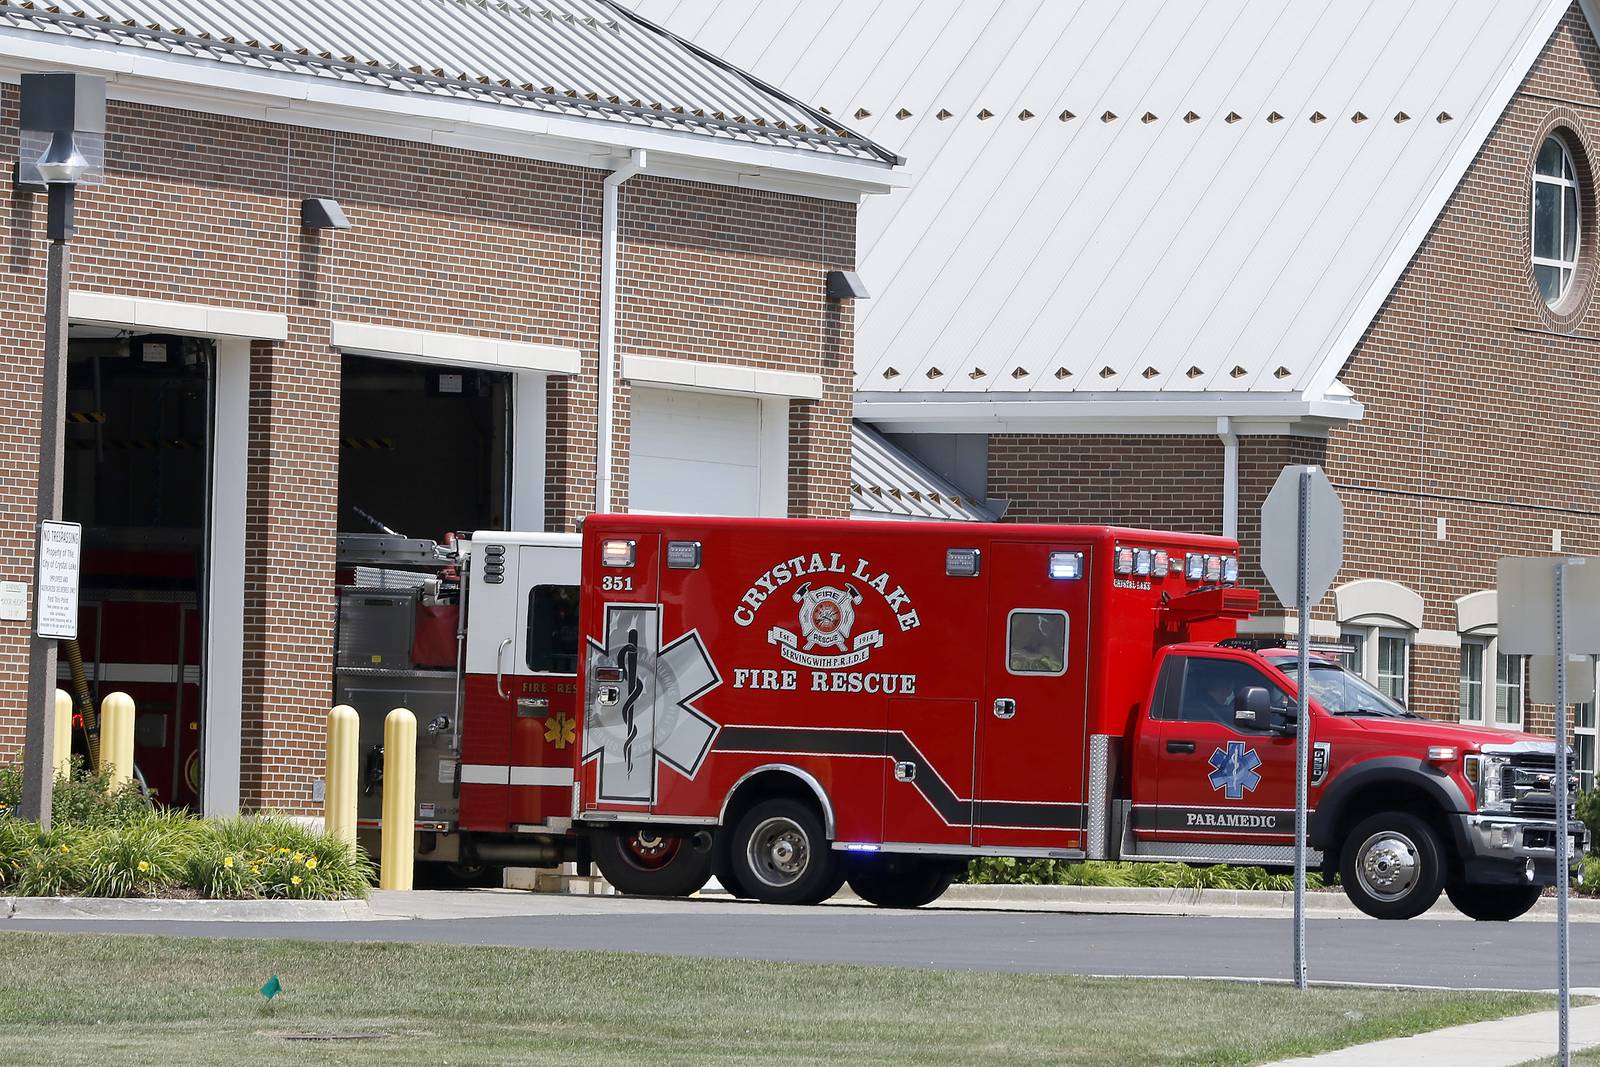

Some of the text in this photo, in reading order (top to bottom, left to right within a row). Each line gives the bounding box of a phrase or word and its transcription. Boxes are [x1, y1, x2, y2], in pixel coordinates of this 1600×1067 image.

[43, 530, 79, 544] NO TRESPASSING
[46, 547, 61, 559] Property
[42, 559, 50, 570] City
[55, 560, 67, 571] Crystal
[602, 575, 633, 591] 351
[733, 552, 921, 633] CRYSTAL LAKE
[815, 590, 840, 600] FIRE
[813, 633, 838, 644] RESCUE
[859, 634, 874, 645] 1914
[782, 647, 812, 663] SERVING
[812, 658, 832, 668] WITH
[522, 682, 548, 693] FIRE
[733, 668, 916, 694] FIRE RESCUE
[1186, 813, 1276, 828] PARAMEDIC
